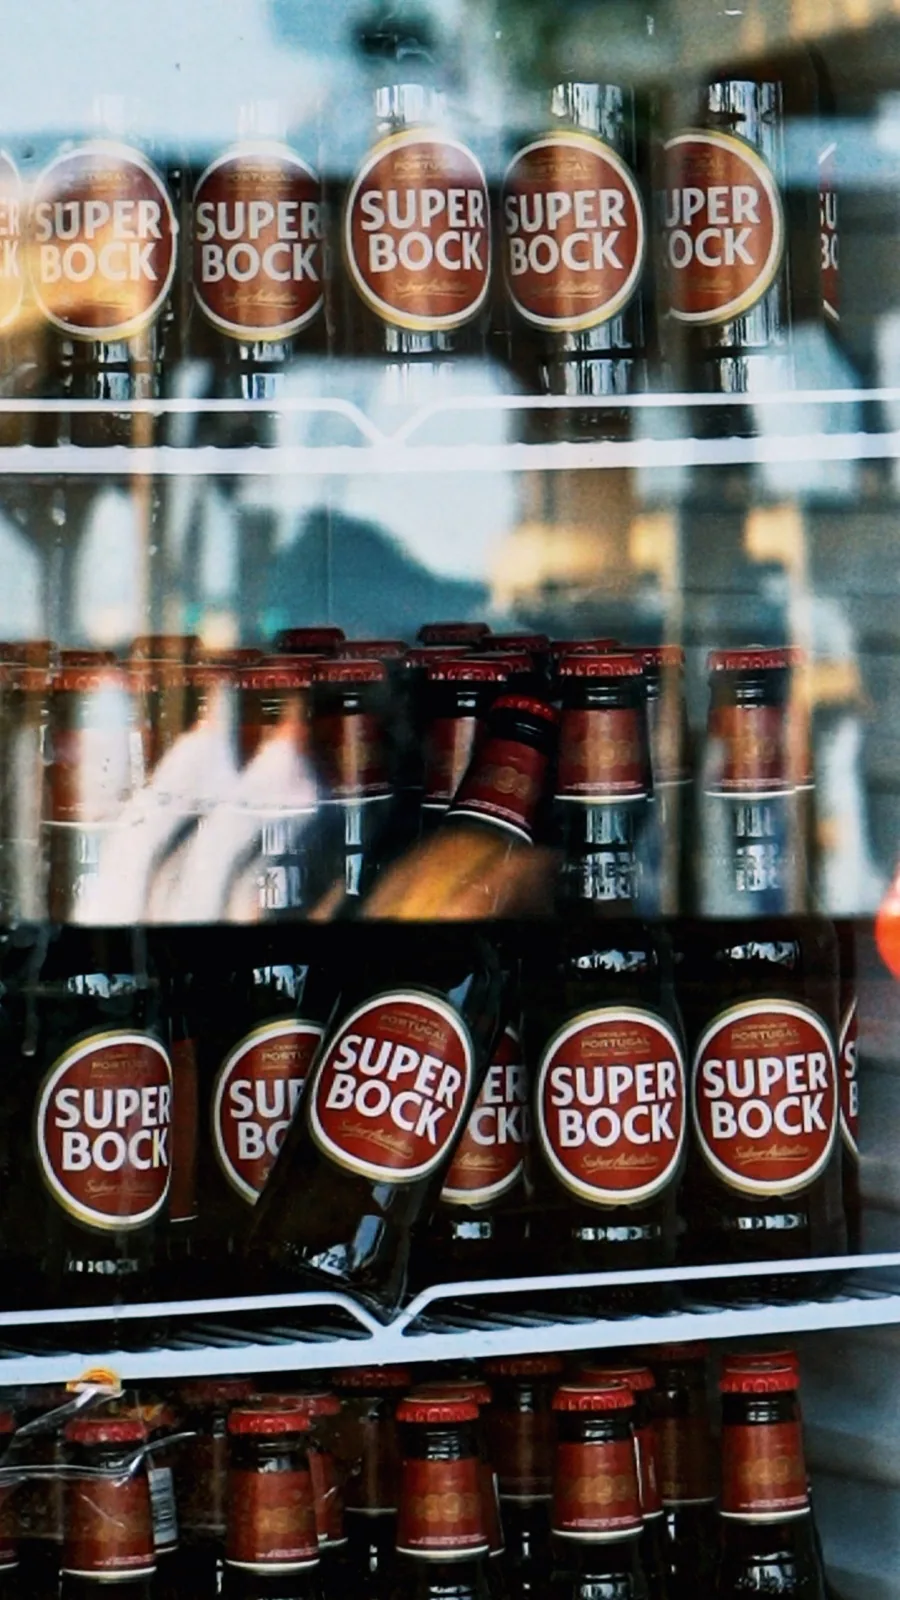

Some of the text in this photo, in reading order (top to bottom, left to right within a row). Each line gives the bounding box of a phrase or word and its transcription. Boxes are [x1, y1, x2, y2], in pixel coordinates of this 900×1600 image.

[35, 200, 163, 241] SUPER
[196, 201, 325, 240] SUPER
[360, 189, 486, 231] SUPER
[505, 188, 627, 235] SUPER
[665, 184, 761, 228] UPER
[40, 242, 158, 283] BOCK
[201, 242, 320, 282] BOCK
[368, 231, 484, 273] BOCK
[508, 230, 624, 276] BOCK
[668, 227, 756, 269] OCK
[332, 1034, 461, 1109] SUPER
[550, 1060, 677, 1107] SUPER
[702, 1051, 828, 1099] SUPER
[55, 1084, 171, 1128] SUPER
[325, 1073, 447, 1145] BOCK
[468, 1106, 522, 1145] CK
[558, 1102, 676, 1147] BOCK
[710, 1093, 827, 1139] BOCK
[62, 1127, 169, 1172] BOCK
